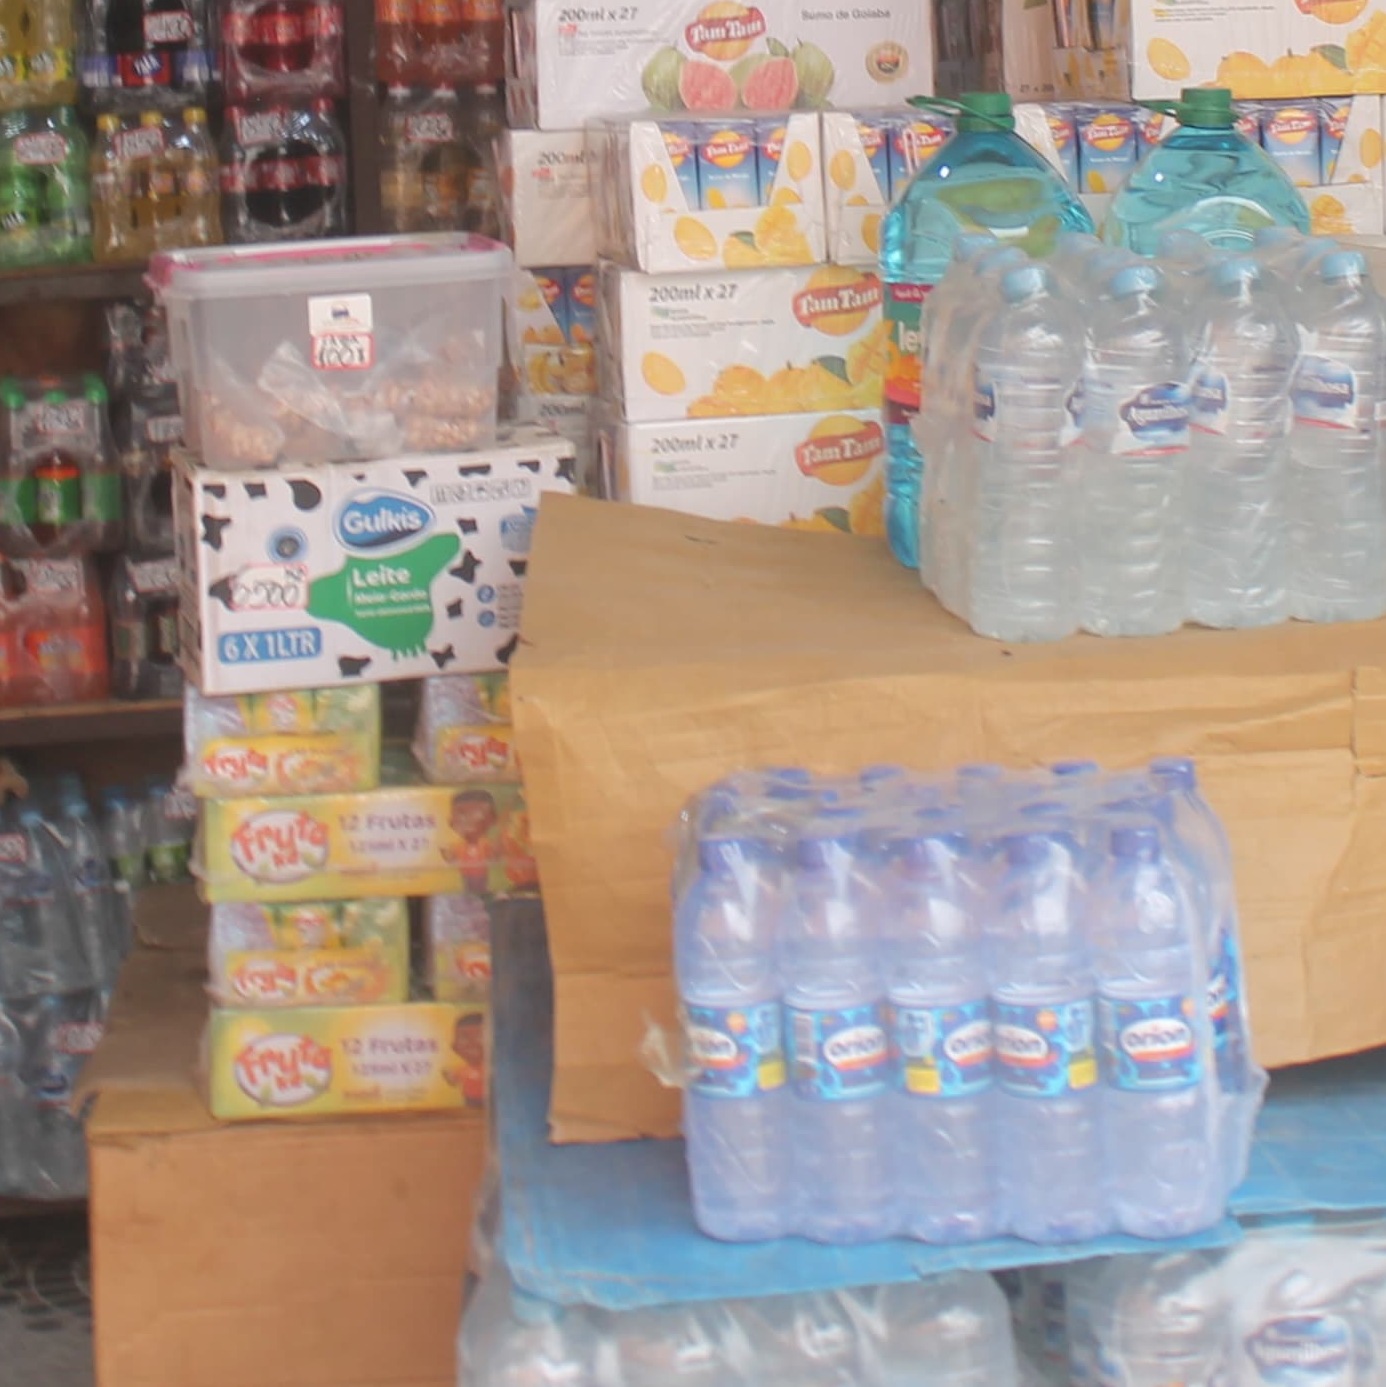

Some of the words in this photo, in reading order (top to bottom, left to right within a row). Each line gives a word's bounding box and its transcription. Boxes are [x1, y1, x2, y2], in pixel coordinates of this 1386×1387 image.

[557, 7, 605, 22] 200ml
[607, 9, 618, 21] x
[619, 6, 639, 22] 27
[852, 8, 891, 21] Goiaba
[648, 284, 703, 303] 200ml
[704, 288, 716, 301] x
[718, 283, 738, 300] 27
[651, 436, 704, 455] 200ml
[705, 439, 717, 452] x
[719, 434, 739, 451] 27
[342, 506, 424, 536] Gulkis
[352, 566, 411, 588] Leite
[222, 637, 239, 662] 6
[241, 635, 261, 660] X
[265, 629, 317, 657] 1LTR
[339, 815, 359, 831] 12
[364, 814, 436, 831] Frutas
[368, 1037, 438, 1054] Frutas
